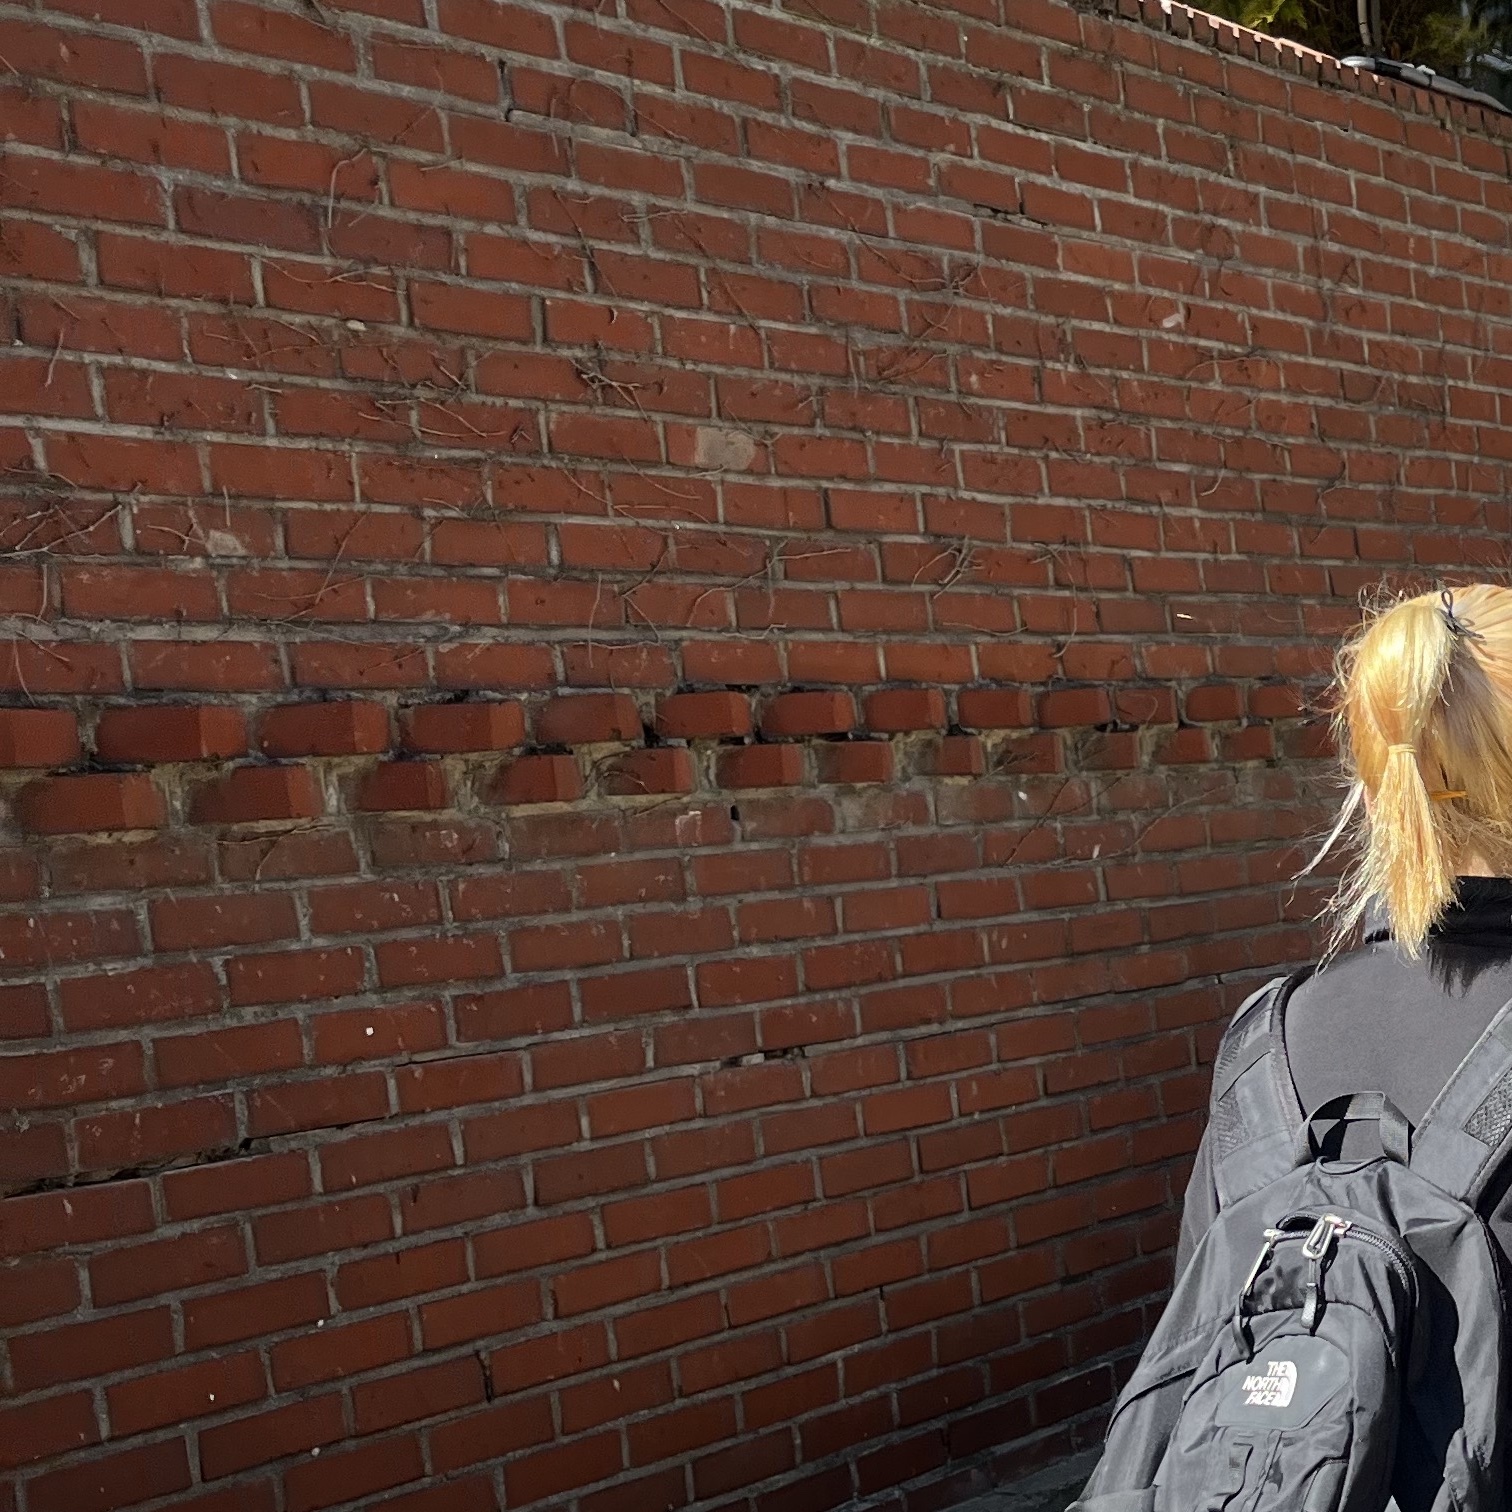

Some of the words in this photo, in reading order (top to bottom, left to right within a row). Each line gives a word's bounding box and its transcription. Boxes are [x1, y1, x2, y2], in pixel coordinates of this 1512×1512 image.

[1266, 1361, 1288, 1377] THE
[1242, 1375, 1281, 1392] NORTH
[1244, 1390, 1275, 1406] FACE
